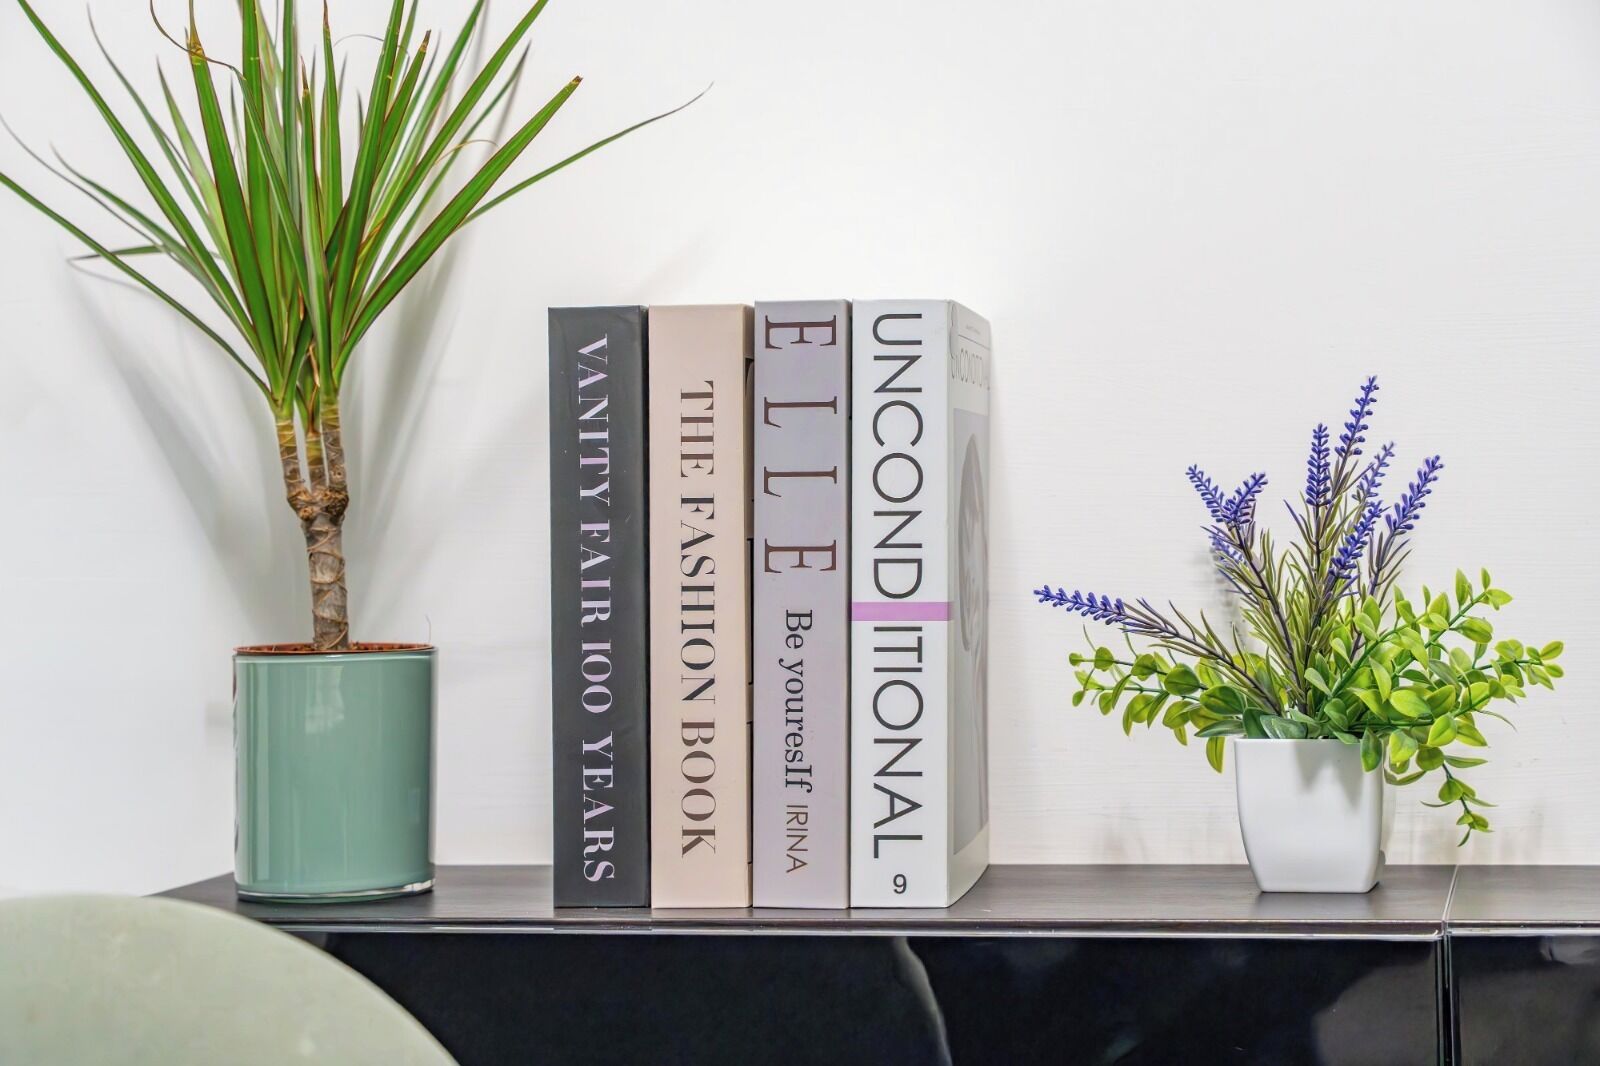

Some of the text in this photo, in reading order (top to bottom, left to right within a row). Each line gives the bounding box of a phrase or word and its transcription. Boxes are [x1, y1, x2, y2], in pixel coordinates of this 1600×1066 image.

[577, 333, 611, 507] VANITY
[763, 314, 838, 574] ELLE
[580, 519, 612, 627] FAIR
[679, 380, 717, 859] THE FASHION BOOK
[784, 609, 813, 650] Be
[582, 731, 616, 882] YEARS
[785, 804, 809, 874] IRINA
[892, 873, 908, 894] 9
